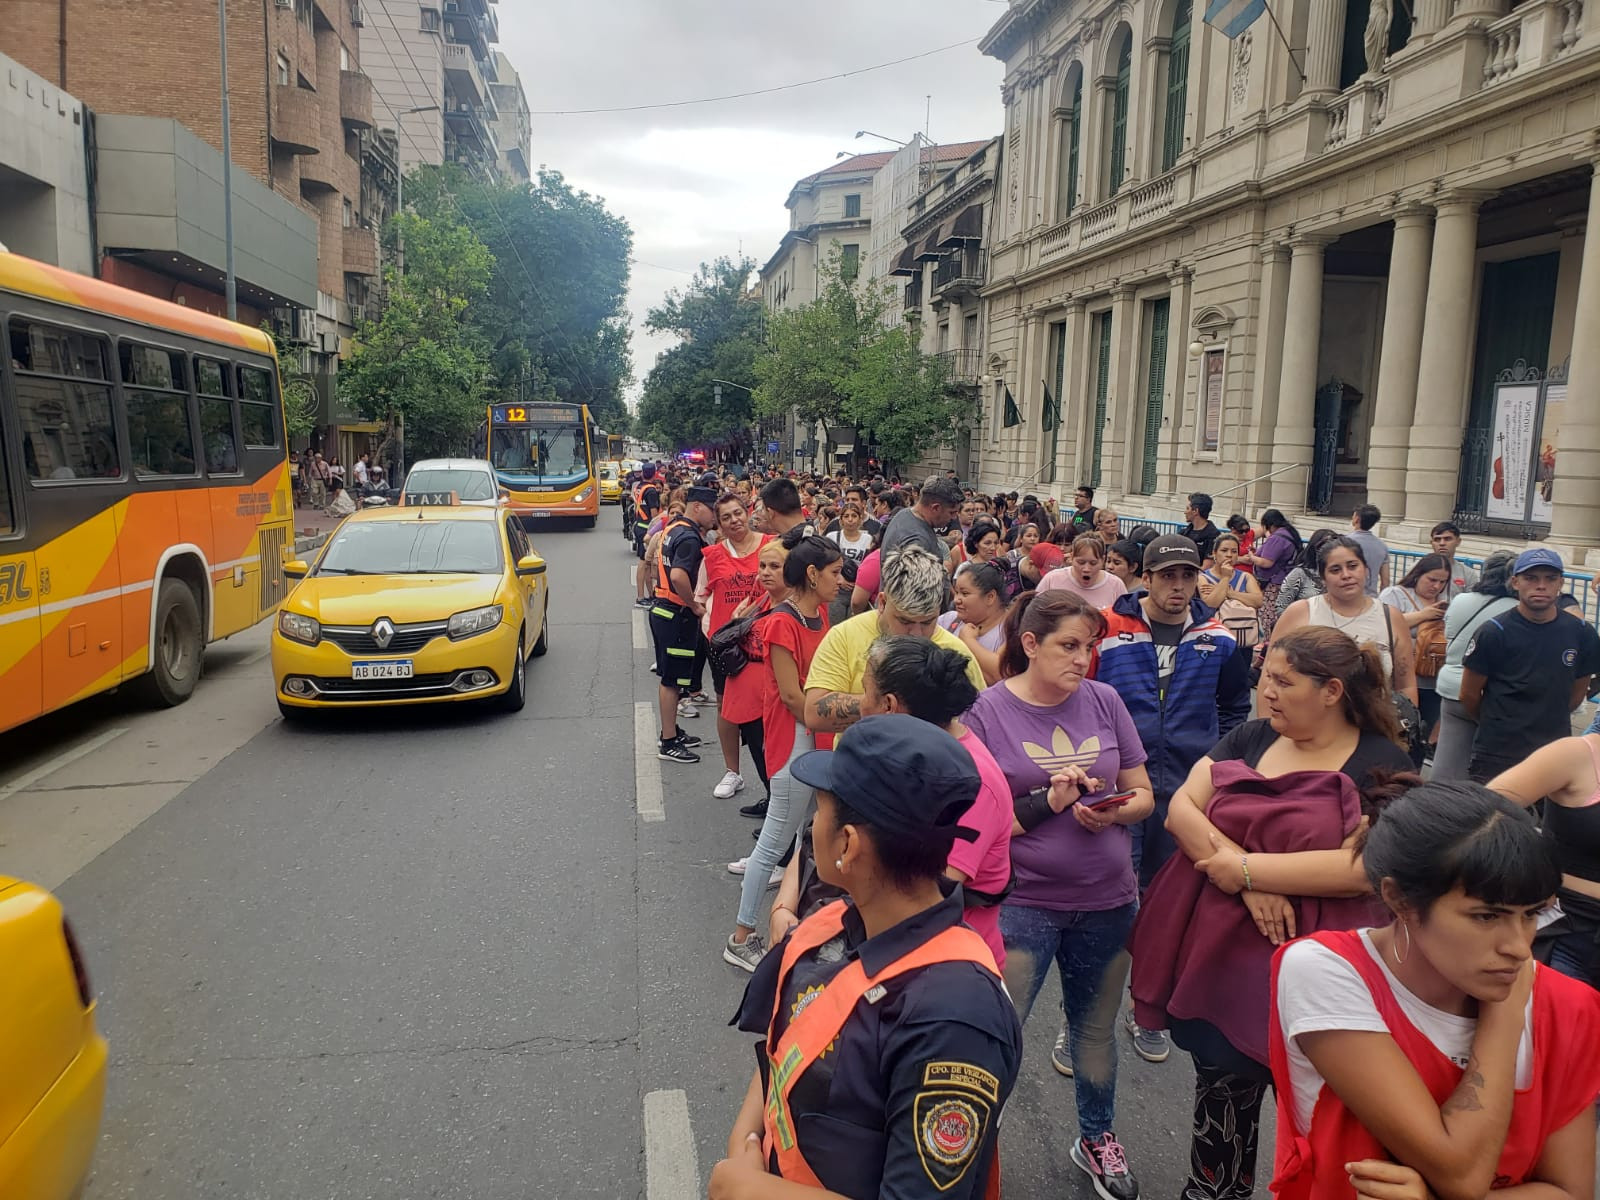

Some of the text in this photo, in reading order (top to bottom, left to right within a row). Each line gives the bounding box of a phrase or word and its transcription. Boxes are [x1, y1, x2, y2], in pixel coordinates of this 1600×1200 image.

[508, 408, 526, 421] 12
[408, 494, 451, 505] TAXI
[1159, 546, 1194, 554] Champion
[355, 665, 410, 678] AB 024 BJ
[951, 1066, 962, 1074] DE
[964, 1067, 995, 1089] VIGILANCIA
[951, 1074, 982, 1088] ESPECIAL
